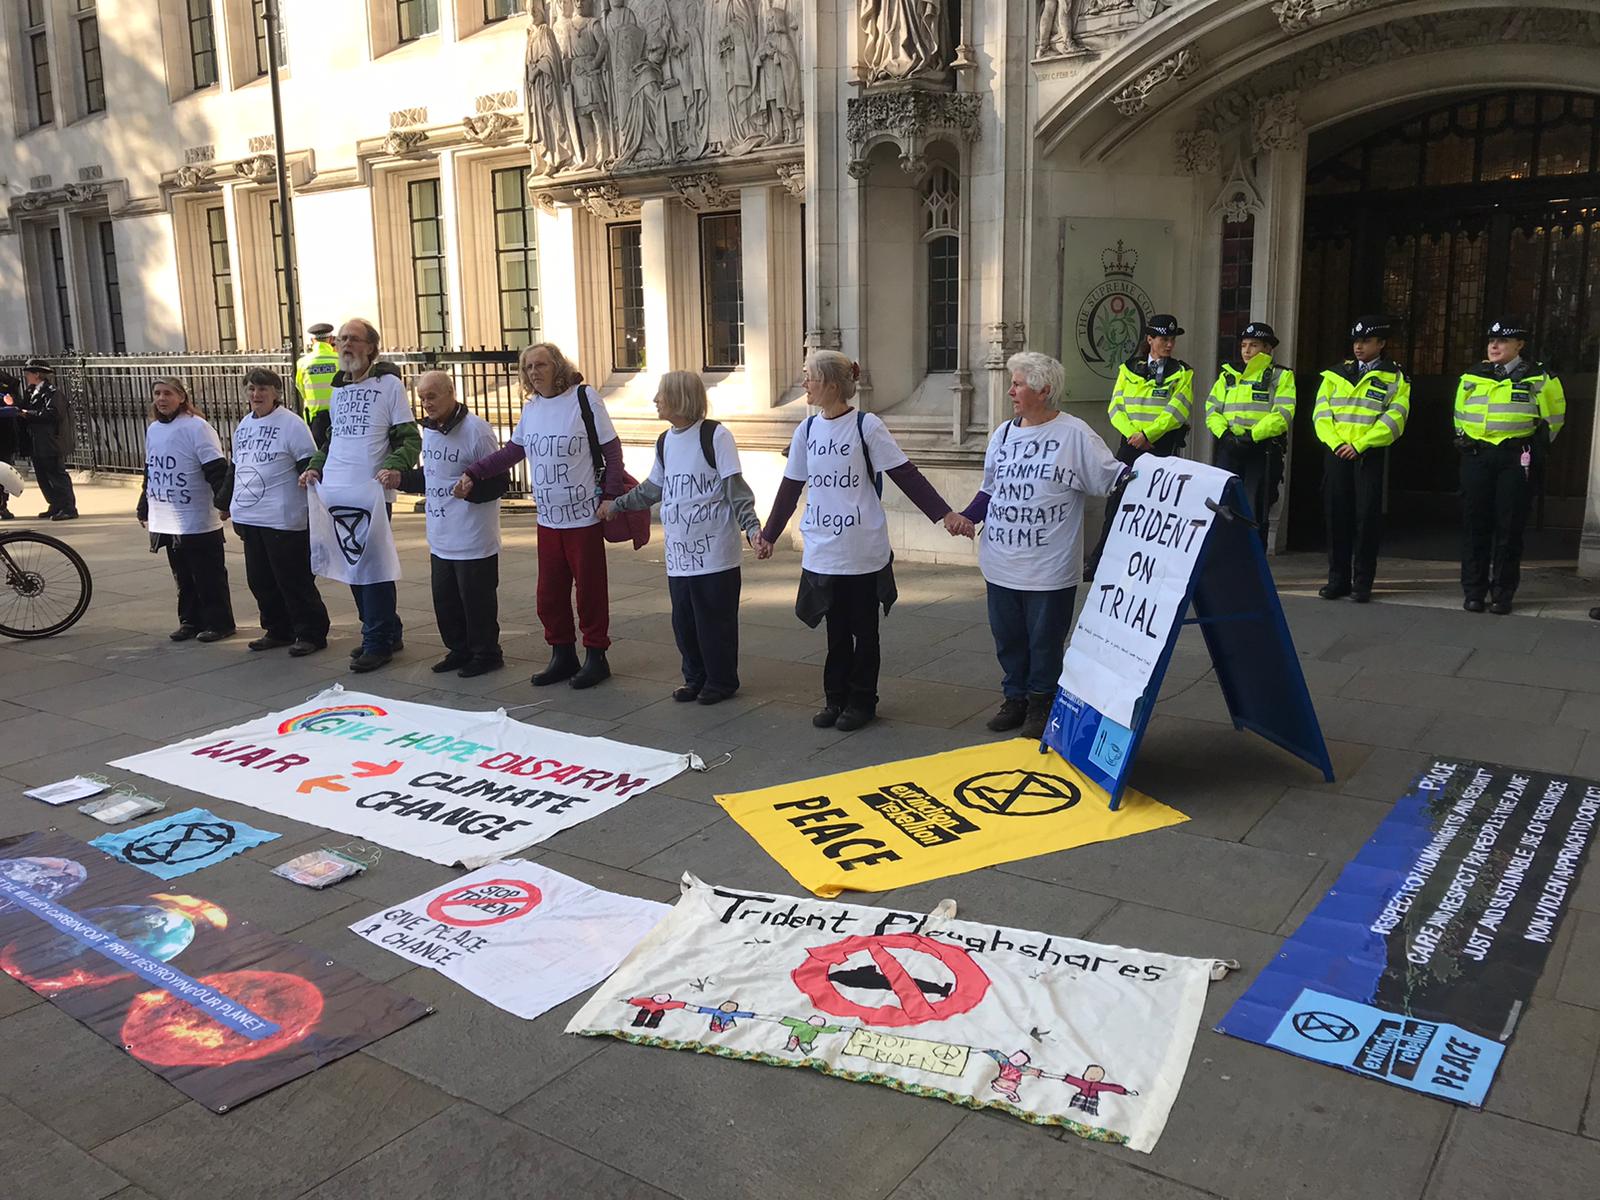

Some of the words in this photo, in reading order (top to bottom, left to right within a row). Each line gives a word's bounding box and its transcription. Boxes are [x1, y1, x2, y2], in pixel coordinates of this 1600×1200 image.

[1079, 310, 1089, 337] THE
[1088, 282, 1136, 307] SUPREME
[1137, 293, 1154, 326] COU
[259, 425, 280, 439] THE
[350, 415, 370, 424] THE
[252, 451, 278, 463] NOW
[524, 433, 585, 457] PROTECT
[807, 438, 850, 456] Make
[996, 440, 1060, 463] STOP
[535, 463, 569, 486] OUR
[808, 465, 860, 488] cocide
[994, 462, 1077, 488] ERNMENT
[1147, 467, 1193, 507] PUT
[149, 488, 192, 504] ALES
[564, 484, 587, 504] TO
[998, 482, 1035, 501] AND
[988, 526, 1049, 548] CRIME
[1119, 503, 1207, 553] TRIDENT
[673, 533, 715, 555] must
[667, 553, 704, 571] SIGN
[1127, 551, 1156, 585] ON
[1099, 584, 1158, 639] TRIAL
[191, 740, 310, 774] WAR
[305, 717, 395, 741] GIVE
[384, 731, 496, 763] HOPE
[477, 751, 650, 797] DISARM
[408, 771, 590, 815] CLIMATE
[1502, 773, 1531, 801] PLANE
[356, 790, 533, 841] CHANGE
[1493, 799, 1519, 814] THE
[773, 795, 903, 871] PEACE
[875, 799, 944, 845] rebellion
[1526, 819, 1548, 834] OF
[1569, 820, 1592, 832] TO
[1369, 890, 1417, 935] RESPECT
[1452, 799, 1476, 817] AND
[480, 885, 521, 899] STOP
[1439, 864, 1479, 914] RESPECT
[384, 909, 430, 931] GIVE
[423, 923, 489, 954] PEACE
[1426, 911, 1455, 930] AND
[1478, 902, 1506, 933] AND
[360, 924, 382, 937] A
[382, 932, 462, 966] CHANCE
[713, 888, 859, 934] Trident
[873, 911, 1168, 982] Ploughshares
[1406, 926, 1443, 966] CARE
[1462, 927, 1495, 961] JUST
[192, 986, 222, 1009] OUR
[216, 1002, 266, 1032] PLANET
[852, 1031, 911, 1049] STOP
[859, 1044, 957, 1073] TRIDENT
[1431, 1036, 1482, 1091] PEACE
